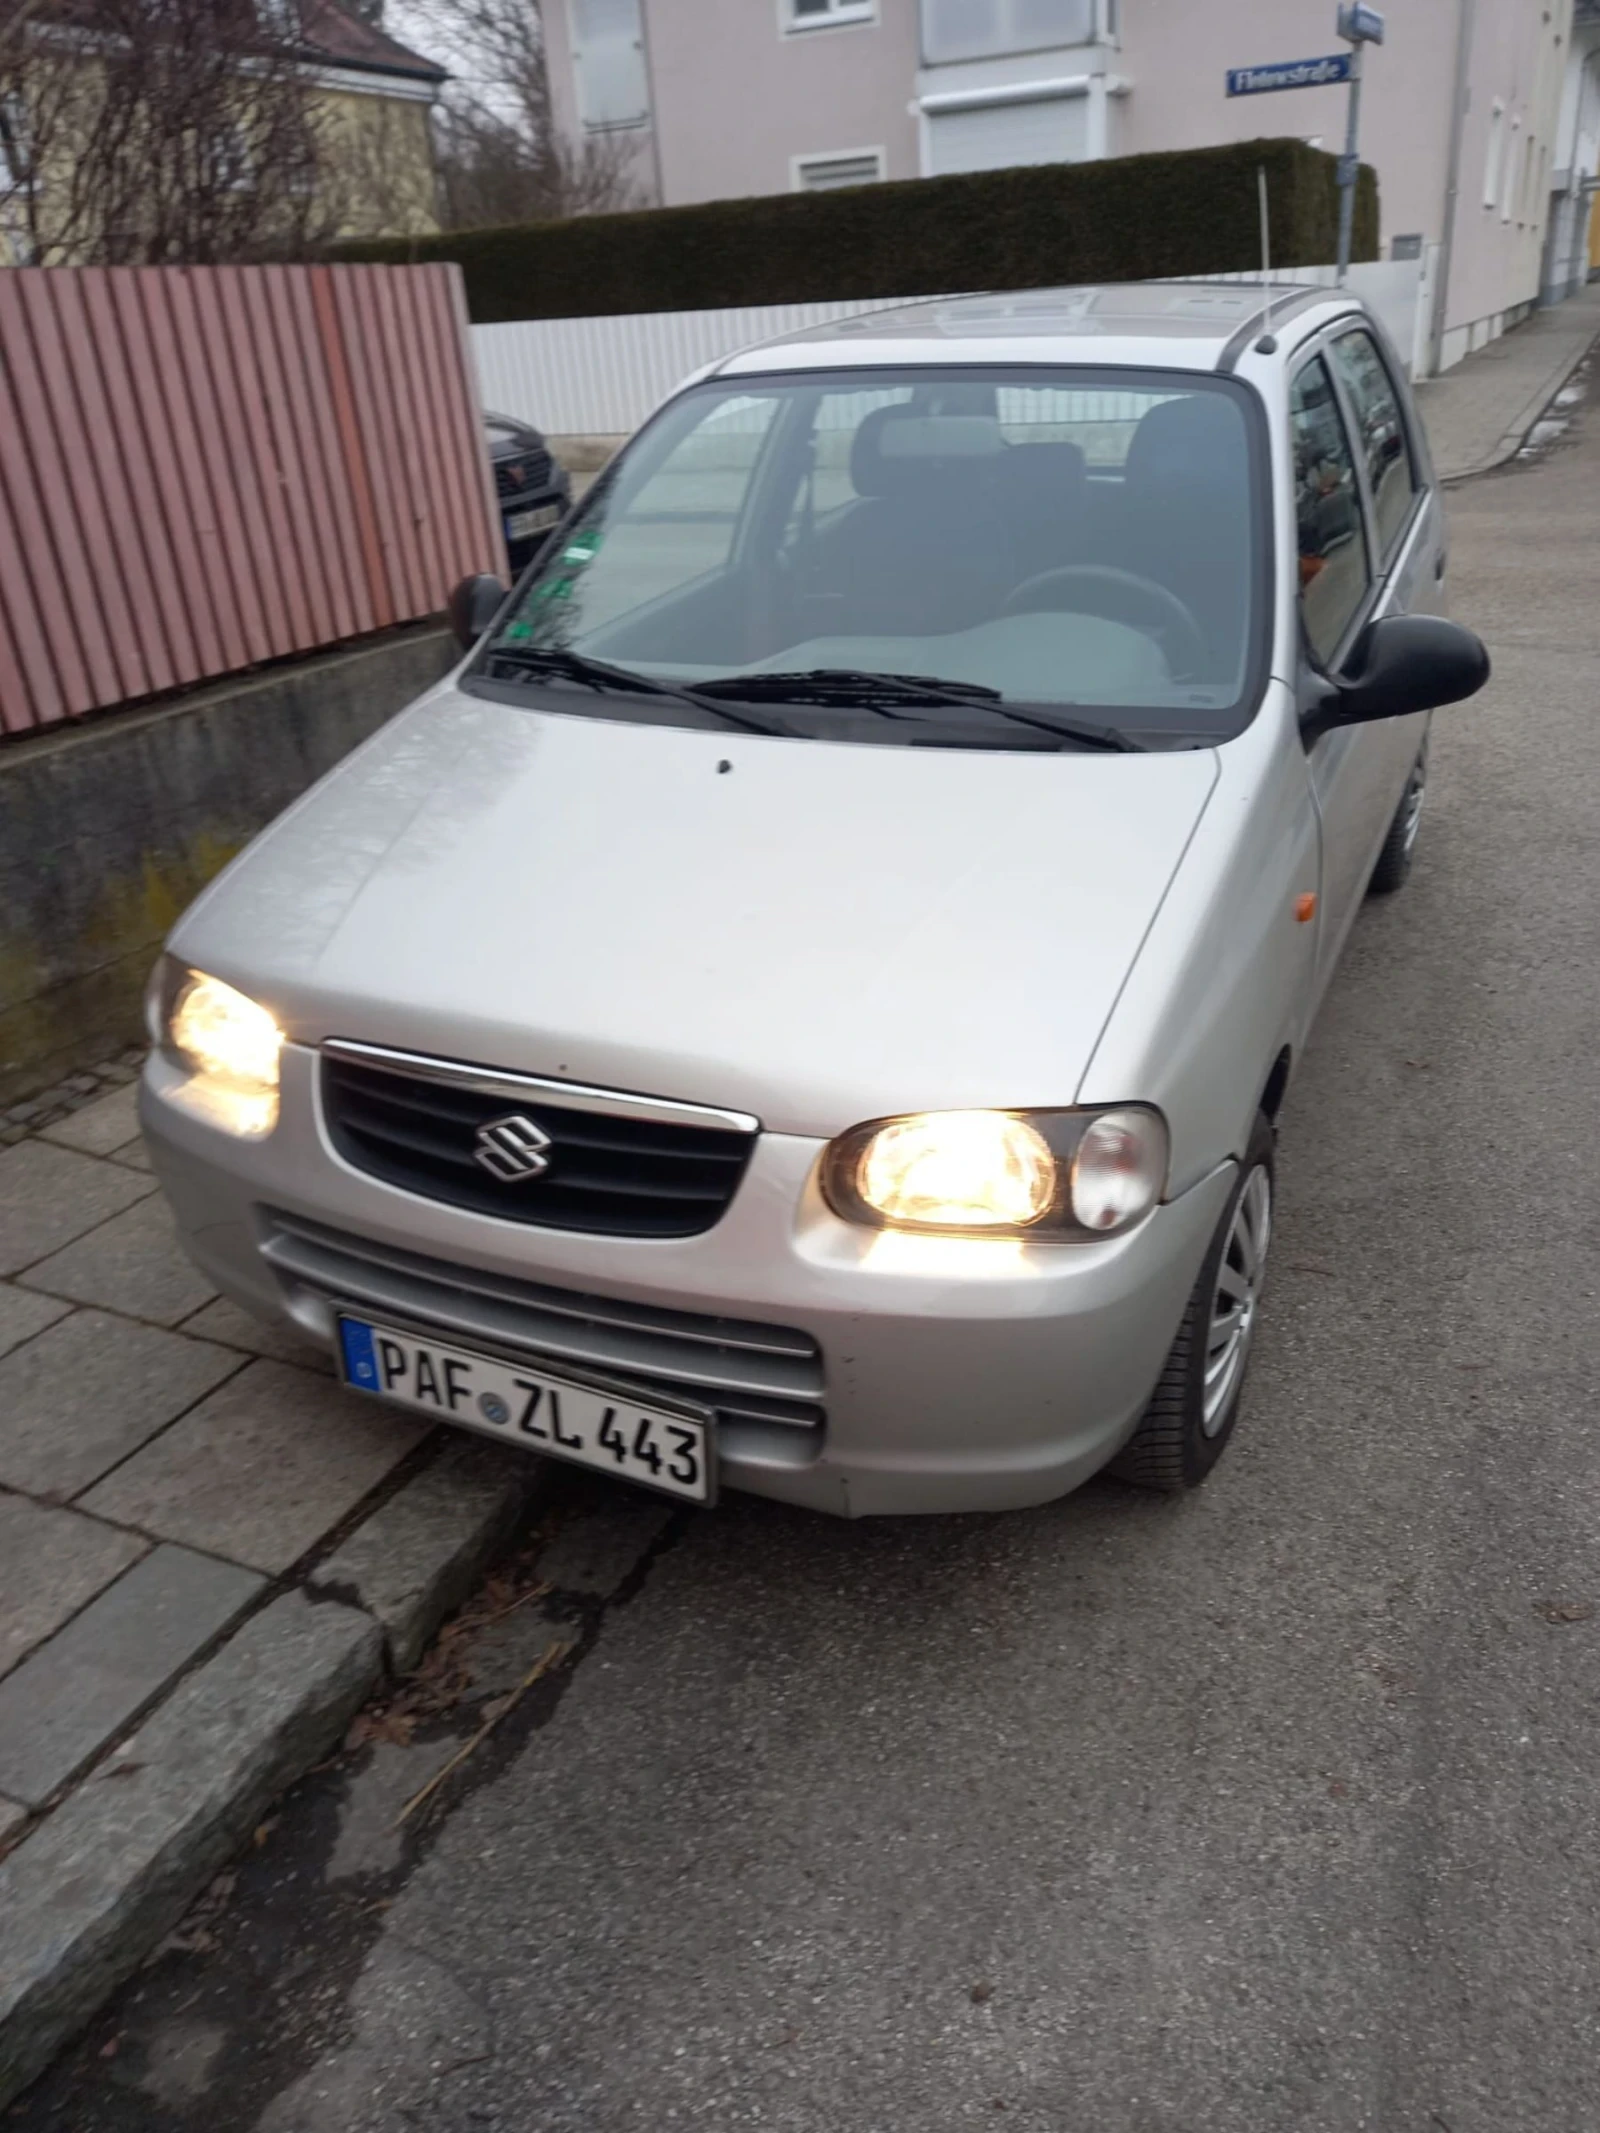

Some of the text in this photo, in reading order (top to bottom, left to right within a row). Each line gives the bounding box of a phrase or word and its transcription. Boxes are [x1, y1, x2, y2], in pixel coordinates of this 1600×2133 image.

[378, 1336, 698, 1486] PAF ZL 443
